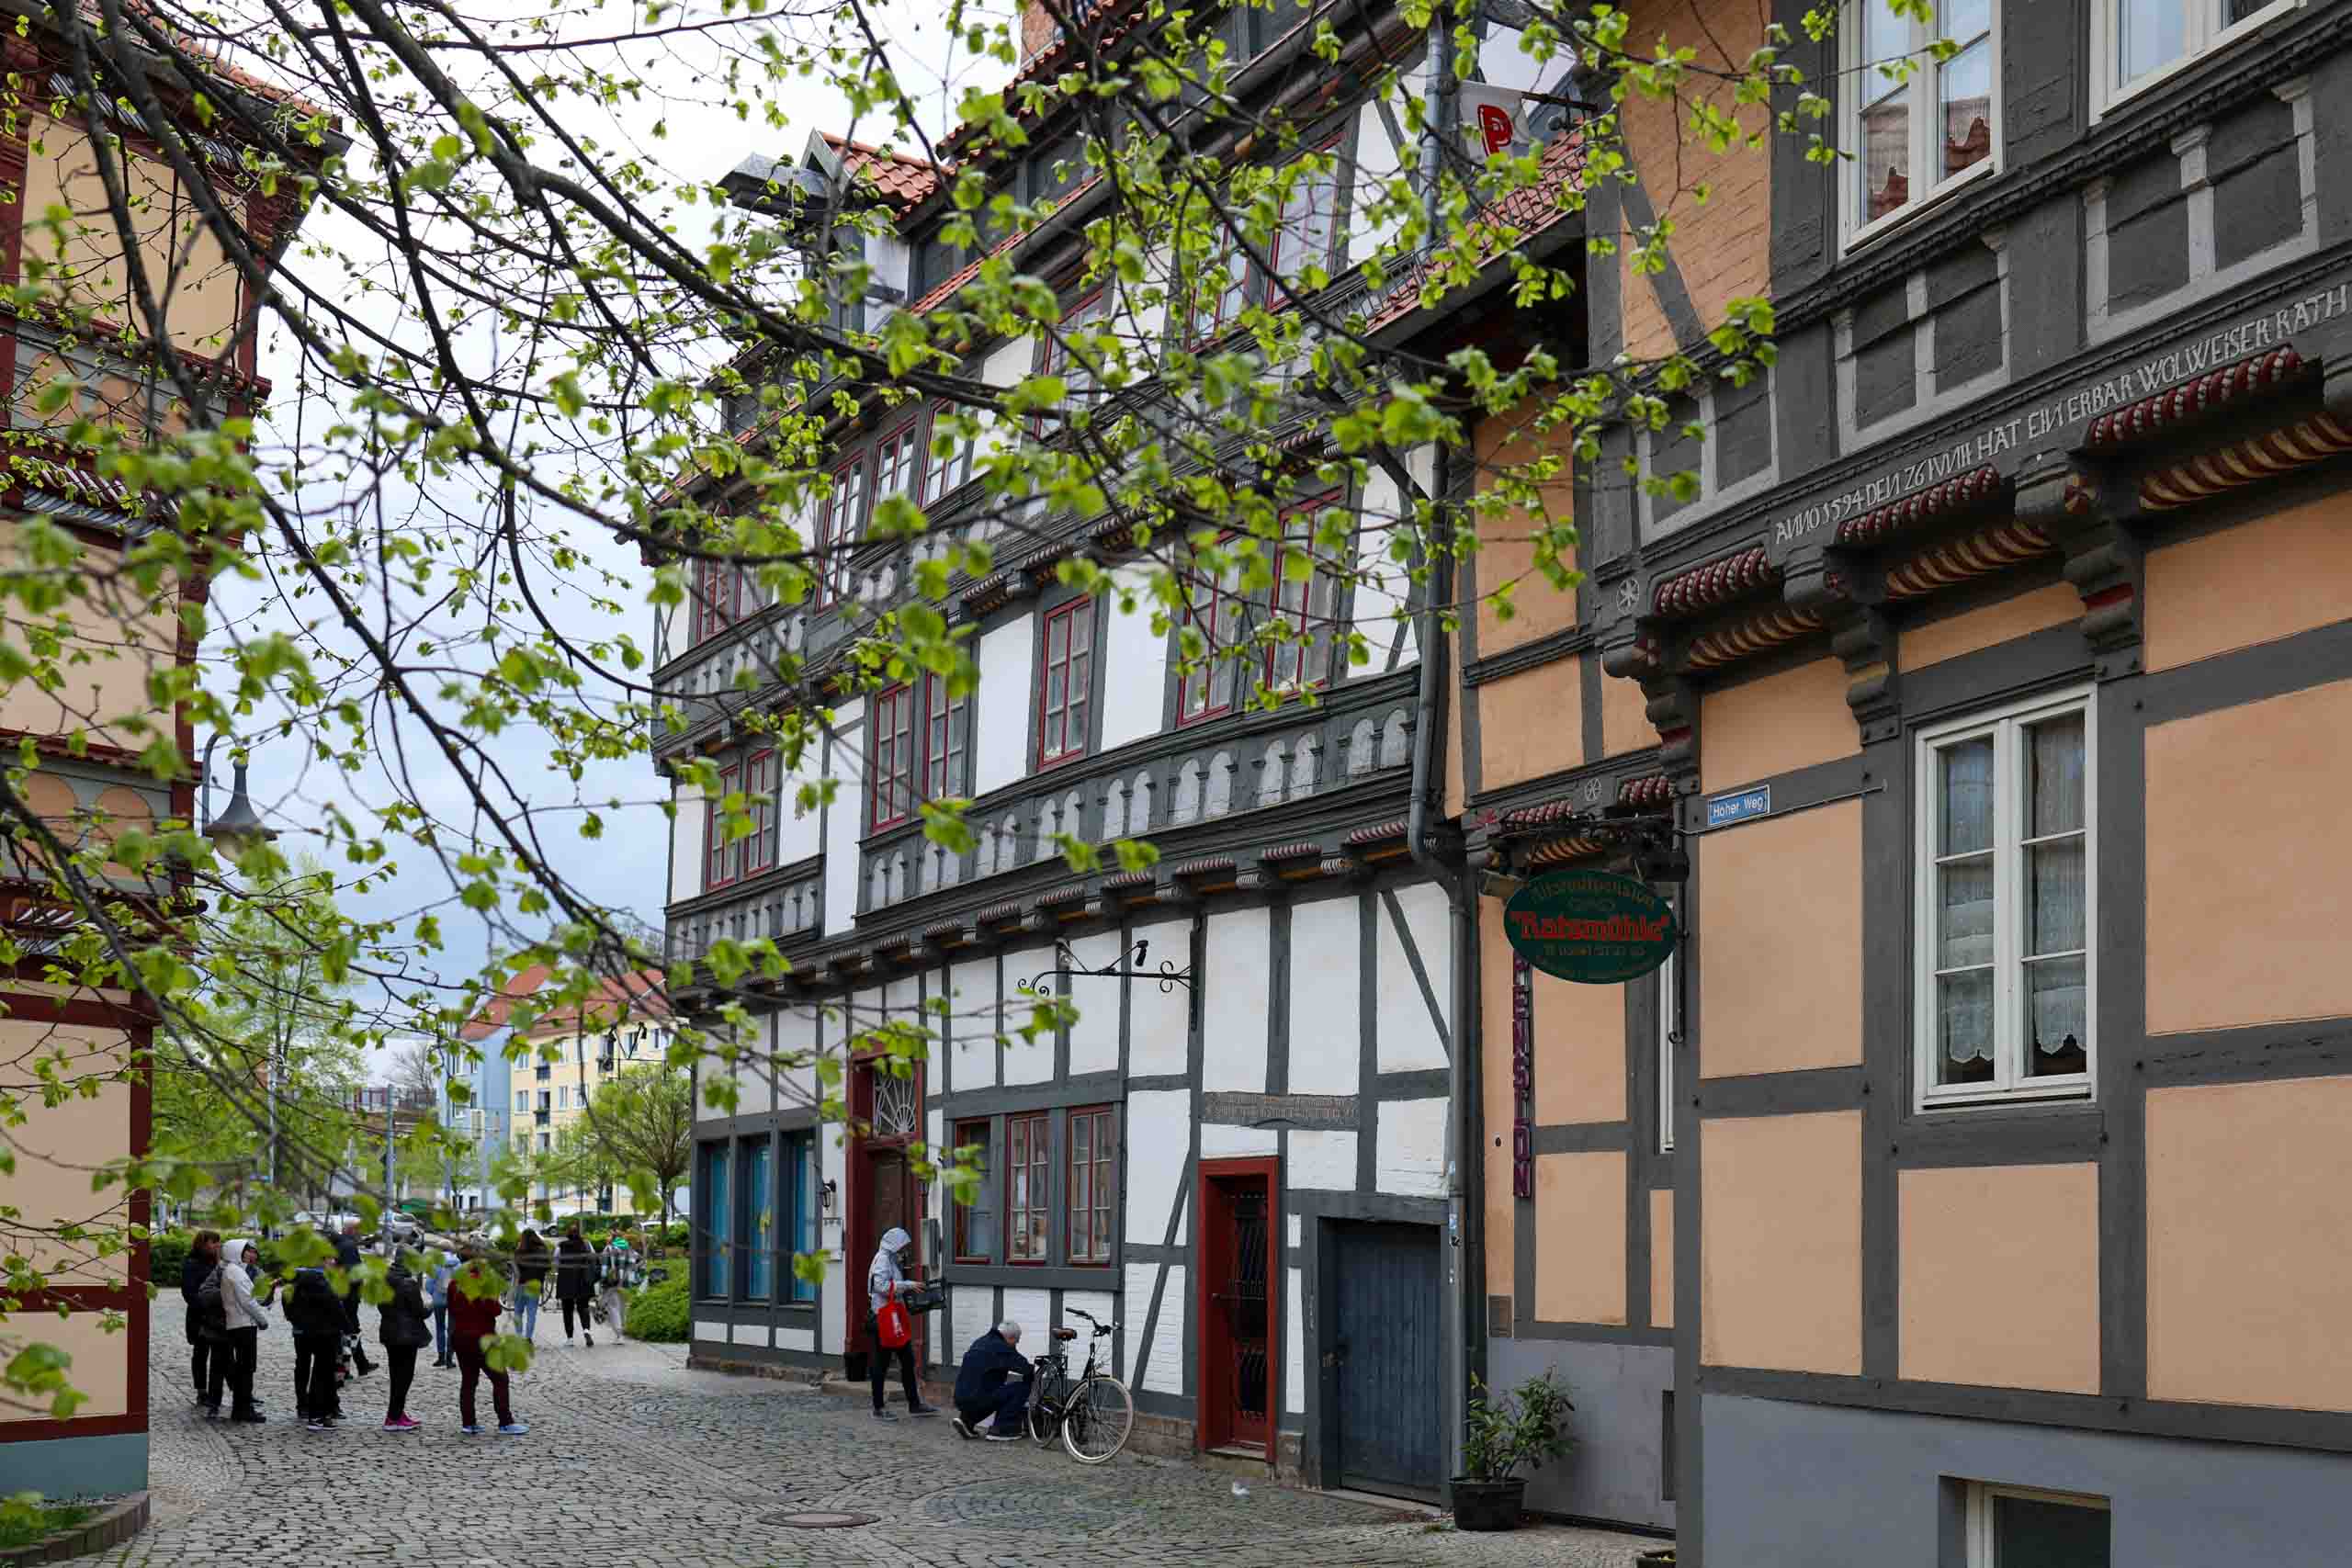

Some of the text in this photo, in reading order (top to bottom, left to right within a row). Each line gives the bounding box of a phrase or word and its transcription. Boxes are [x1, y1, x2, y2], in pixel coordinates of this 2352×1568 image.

[1865, 472, 1901, 507] DEN
[1977, 418, 2022, 461] HAT
[2067, 374, 2135, 424] ERBAR
[2275, 284, 2348, 339] RATH
[1743, 795, 1764, 811] Weg
